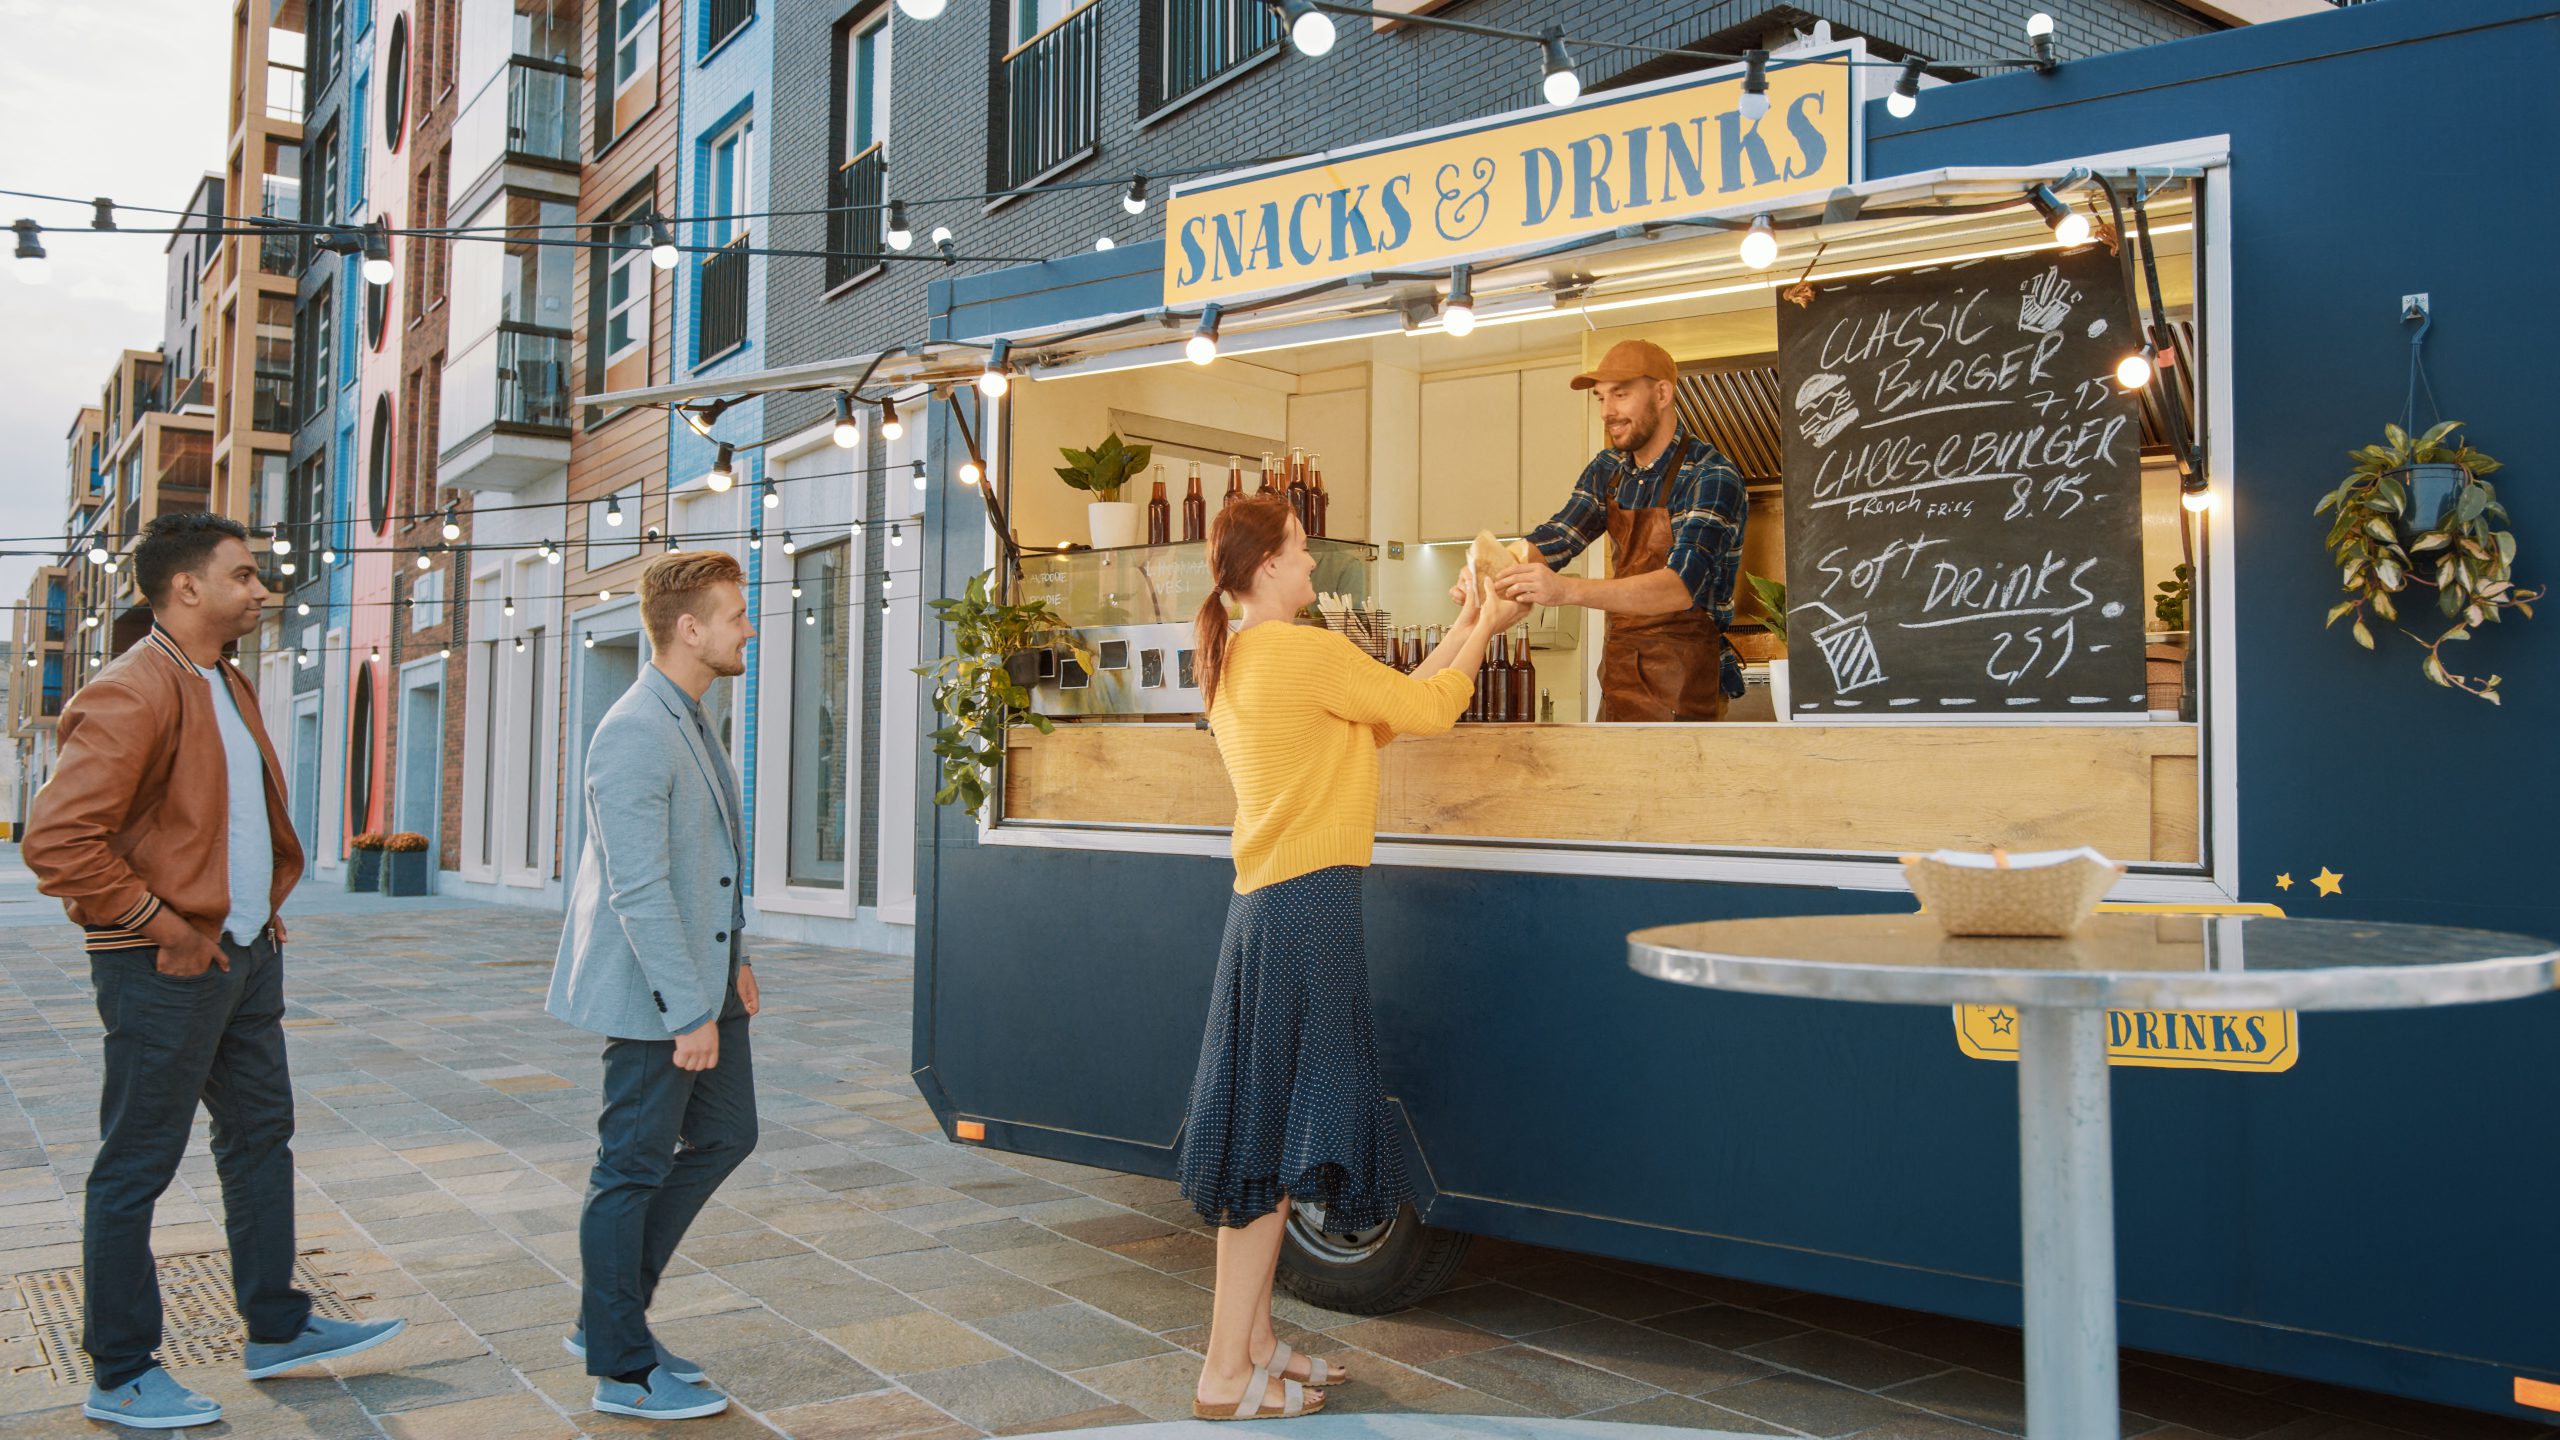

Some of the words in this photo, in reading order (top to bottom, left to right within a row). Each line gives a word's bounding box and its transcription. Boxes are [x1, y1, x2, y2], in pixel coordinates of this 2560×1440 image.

[1177, 172, 1412, 287] SNACKS
[1434, 157, 1496, 241] &
[1520, 90, 1827, 226] DRINKS
[2108, 1011, 2267, 1054] DRINKS
